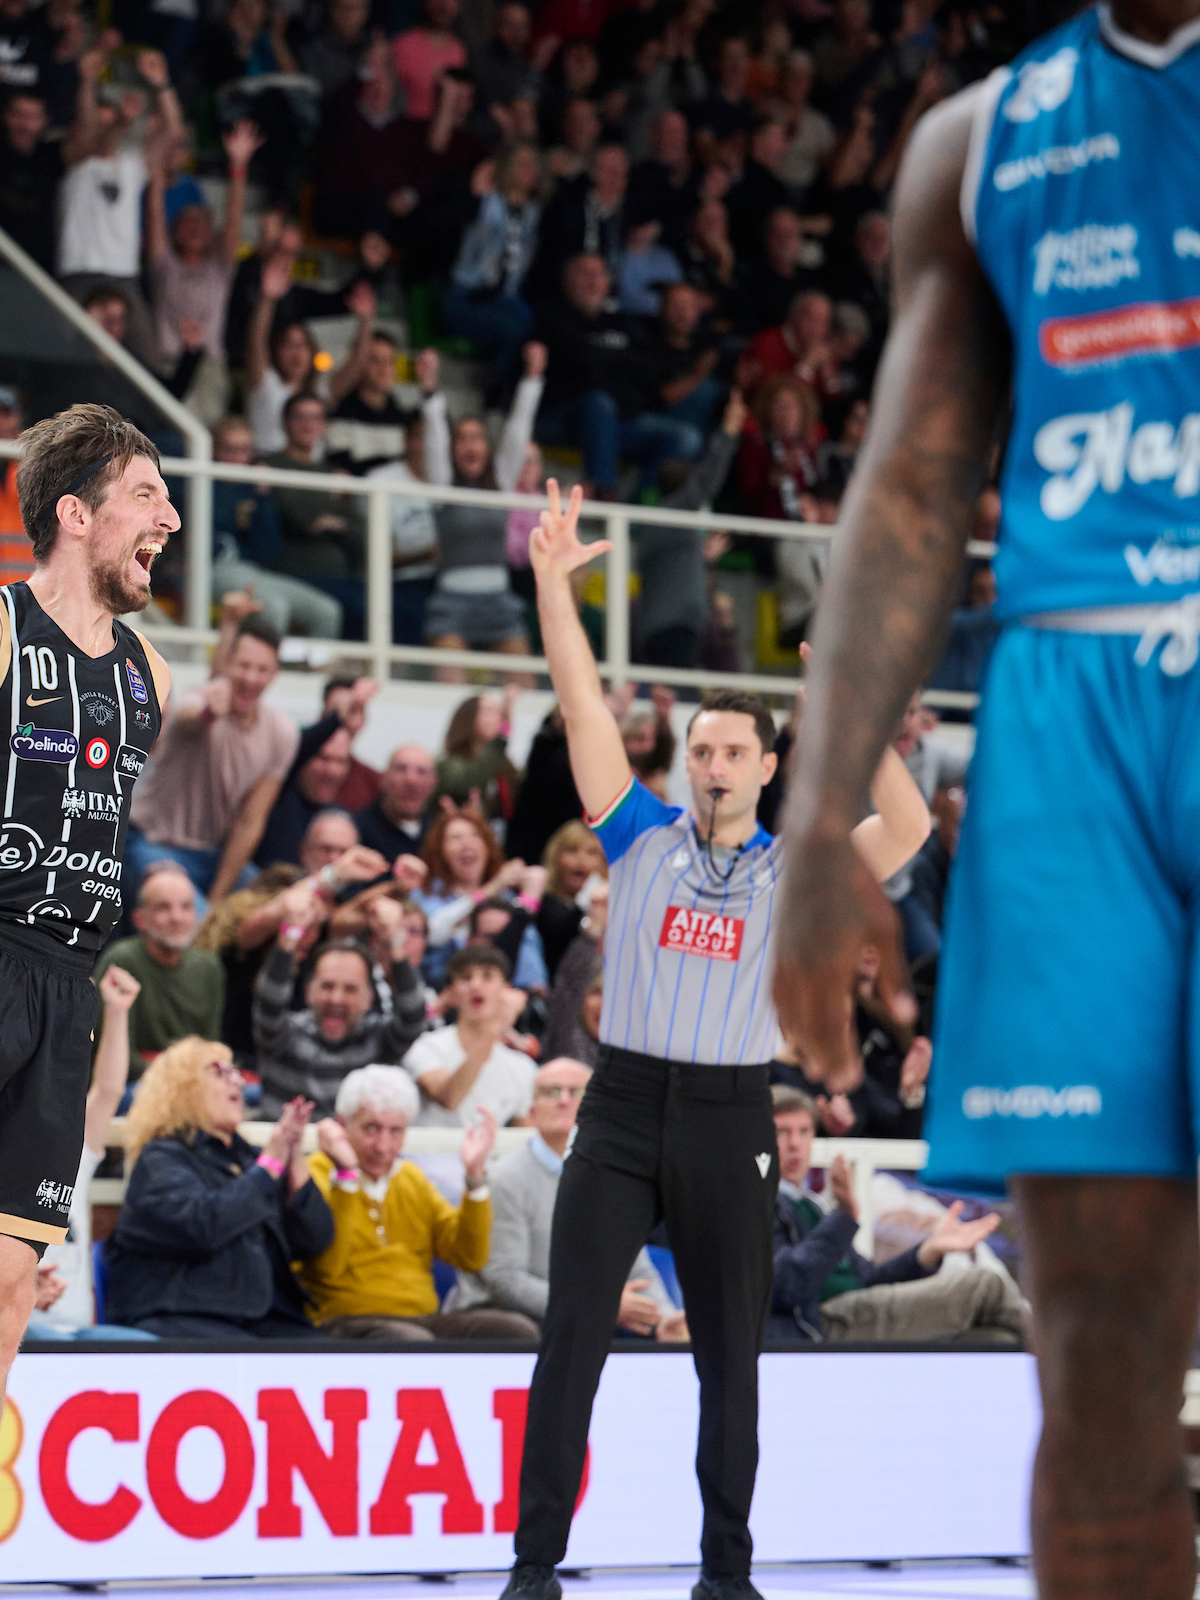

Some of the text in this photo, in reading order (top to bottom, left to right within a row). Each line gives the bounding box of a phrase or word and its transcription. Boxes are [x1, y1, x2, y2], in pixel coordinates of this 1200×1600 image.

[22, 645, 58, 691] 10
[98, 692, 119, 709] BASKET
[14, 736, 76, 754] Melinda
[670, 907, 737, 939] ATTAL
[667, 927, 735, 952] GROUP
